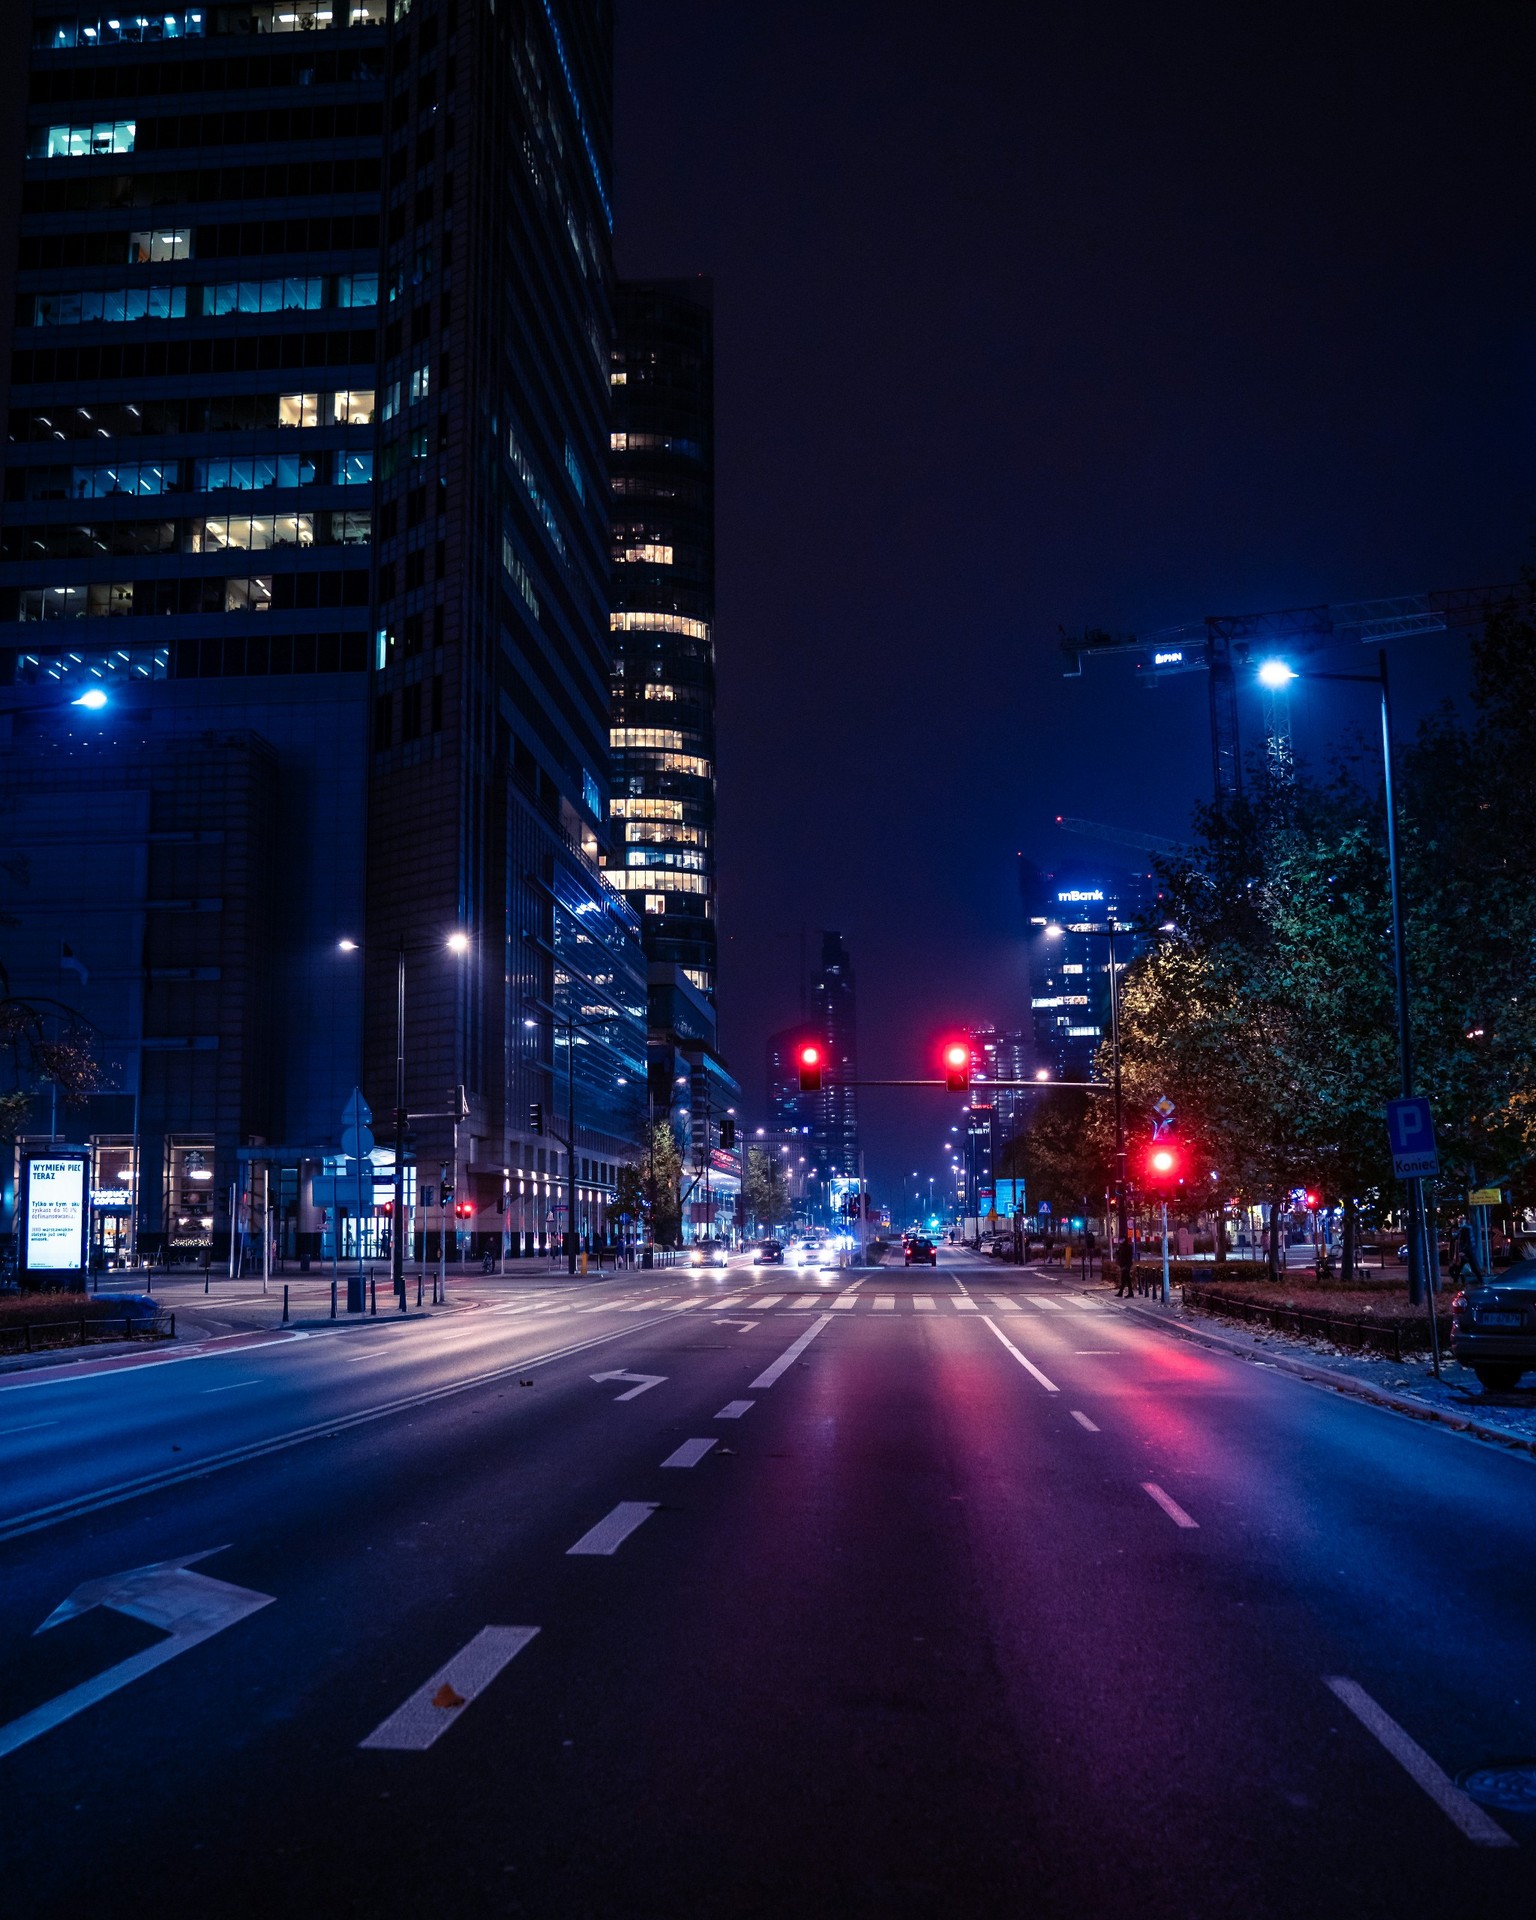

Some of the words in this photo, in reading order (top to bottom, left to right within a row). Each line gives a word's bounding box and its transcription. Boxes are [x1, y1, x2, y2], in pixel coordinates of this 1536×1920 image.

[1058, 890, 1103, 901] mBank
[1397, 1106, 1422, 1146] P
[1395, 1158, 1436, 1173] Koniec
